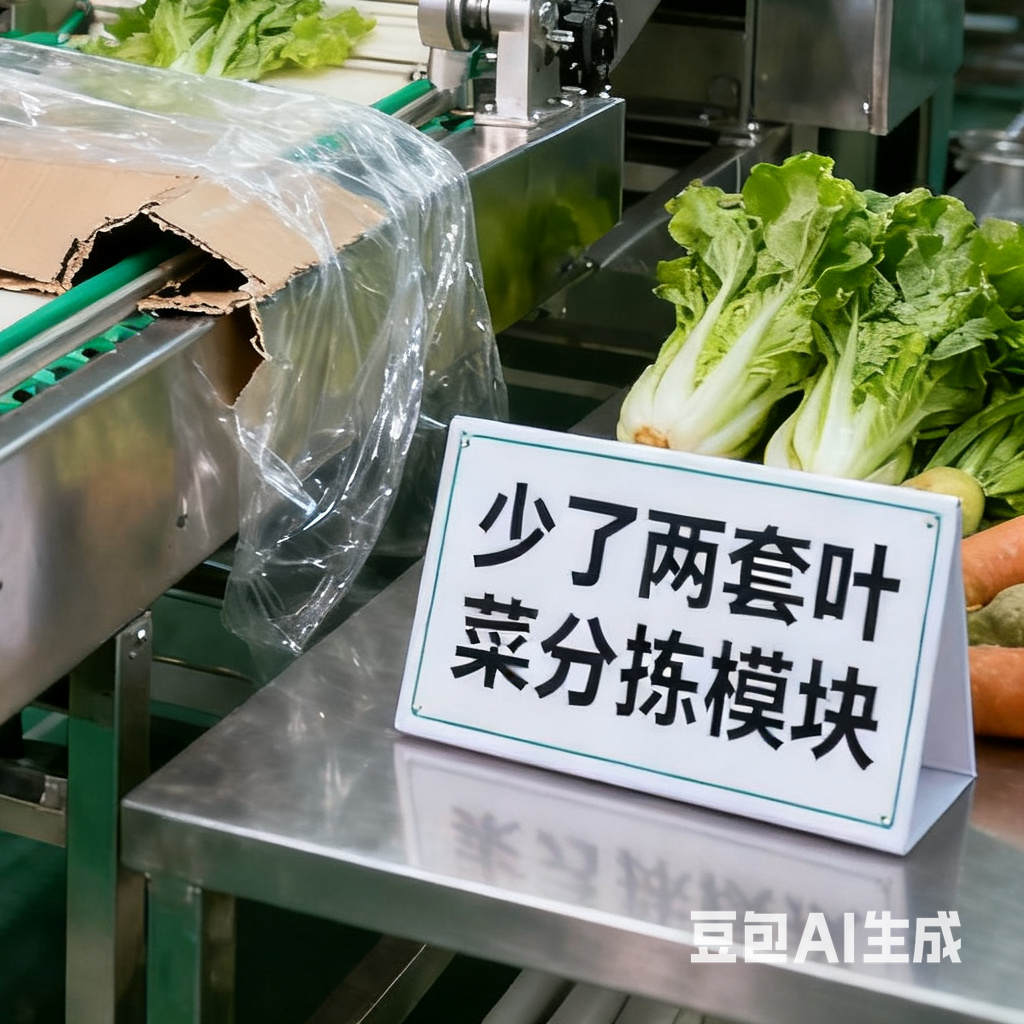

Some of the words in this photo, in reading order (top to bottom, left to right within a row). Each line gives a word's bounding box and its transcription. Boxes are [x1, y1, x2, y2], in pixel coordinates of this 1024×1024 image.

[473, 482, 900, 642] 少了两套叶
[451, 593, 878, 770] 菜分拣模块
